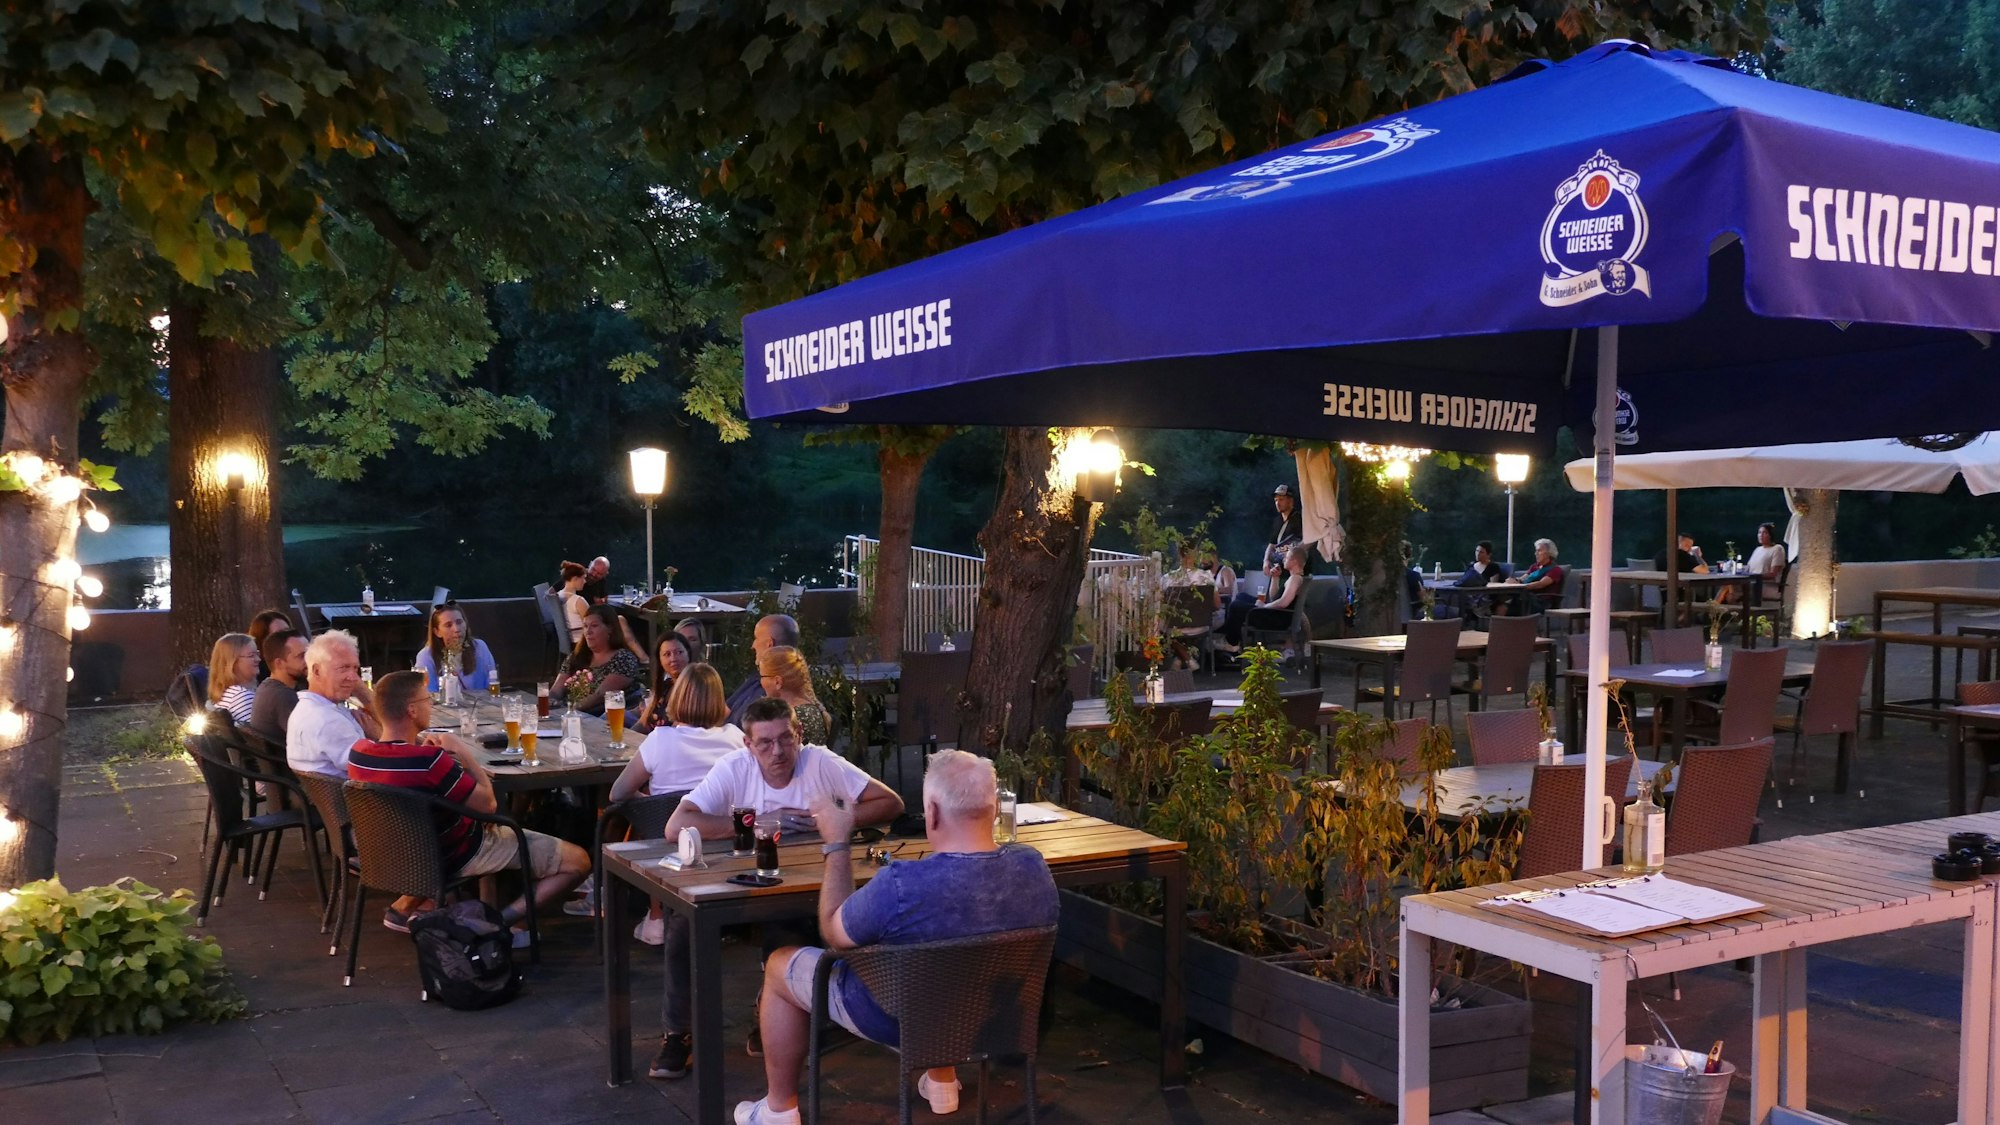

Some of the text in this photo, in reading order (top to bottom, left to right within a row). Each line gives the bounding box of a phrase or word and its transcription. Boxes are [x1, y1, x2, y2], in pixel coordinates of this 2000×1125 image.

[1261, 154, 1357, 166] EIDER
[1558, 214, 1624, 239] SCHNEIDER
[1787, 184, 2000, 276] SCHNEIDE
[1566, 233, 1613, 254] WEISSE
[1550, 286, 1577, 299] Schneider
[1583, 278, 1598, 291] Sohn
[764, 298, 952, 384] SCHNEIDER WEISSE
